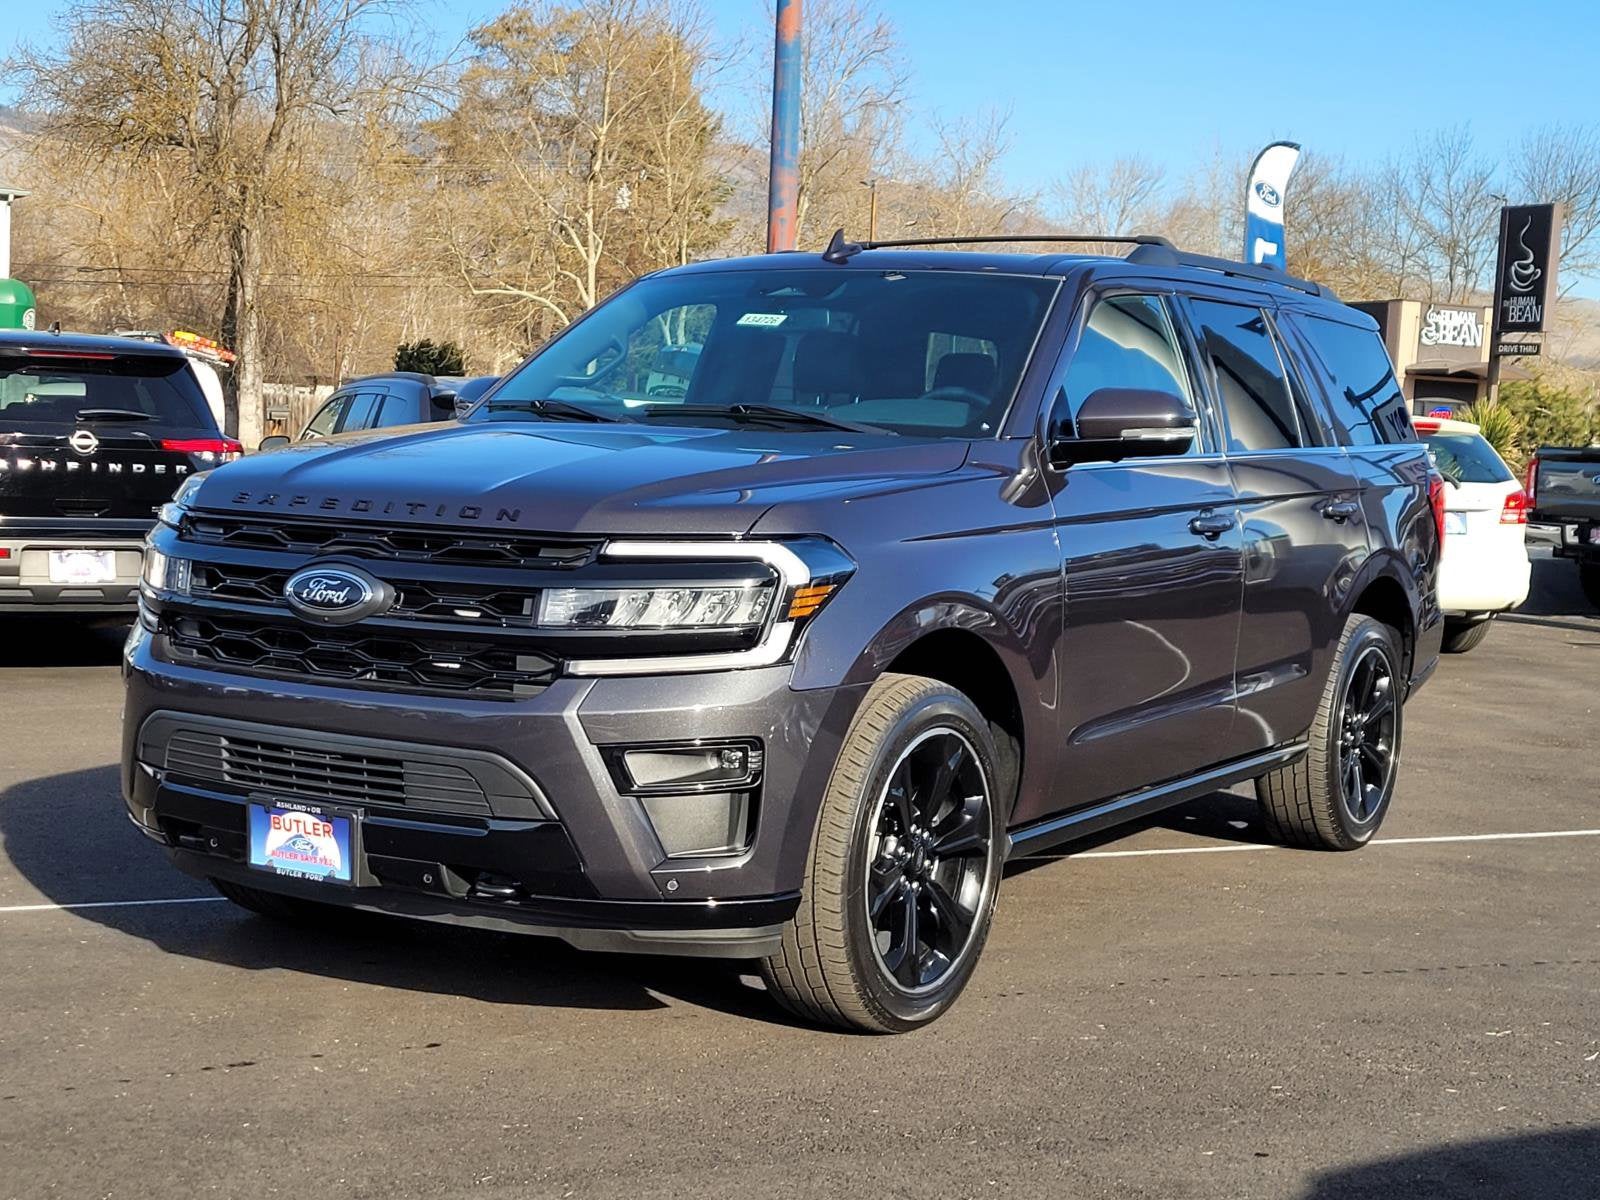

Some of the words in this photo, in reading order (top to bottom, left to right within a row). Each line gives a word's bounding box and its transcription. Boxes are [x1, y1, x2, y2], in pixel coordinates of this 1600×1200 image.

[1510, 296, 1536, 306] HUMAN
[1439, 309, 1476, 323] HUMAN
[1508, 305, 1541, 322] BEAN
[1438, 322, 1483, 347] BEAN
[1498, 345, 1518, 353] DRIVE
[1520, 345, 1537, 353] THRU
[232, 491, 521, 522] EXPEDITION
[302, 577, 351, 604] Ford
[276, 802, 306, 812] ASHLAND
[311, 806, 321, 814] OR
[272, 816, 332, 838] BUTLER
[271, 849, 299, 860] BUTLER
[300, 855, 318, 864] SAYS
[276, 868, 302, 878] BUTLER
[305, 873, 324, 881] FORD
